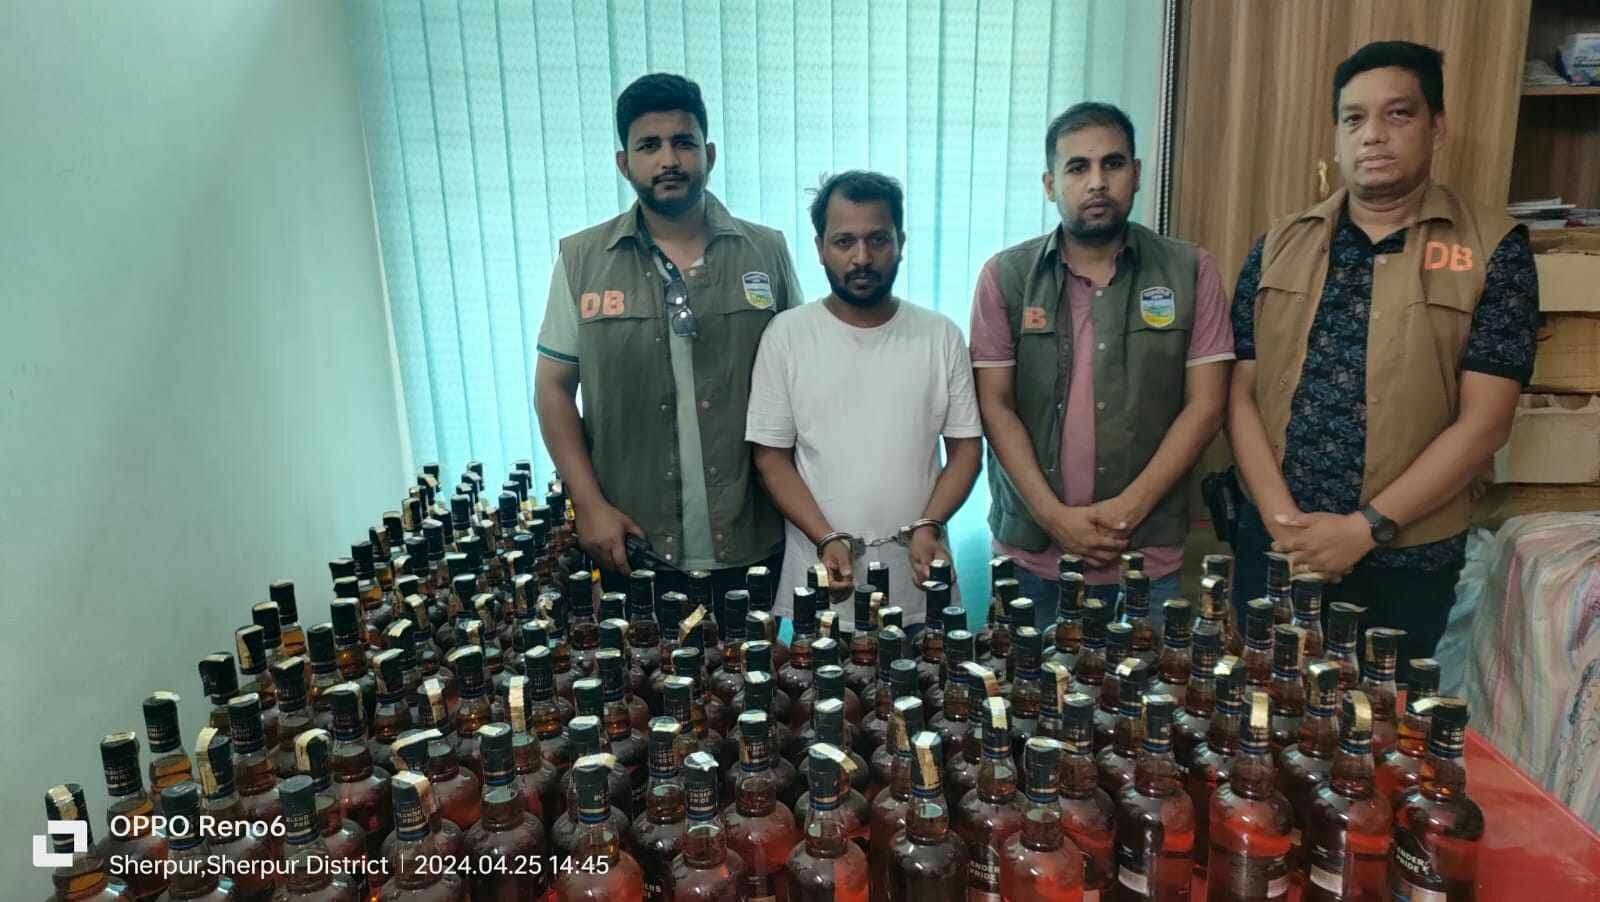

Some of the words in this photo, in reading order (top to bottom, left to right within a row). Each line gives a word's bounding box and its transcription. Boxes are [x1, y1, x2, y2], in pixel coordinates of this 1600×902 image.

[1423, 240, 1473, 272] DB
[580, 289, 625, 319] DB
[1023, 306, 1047, 330] B
